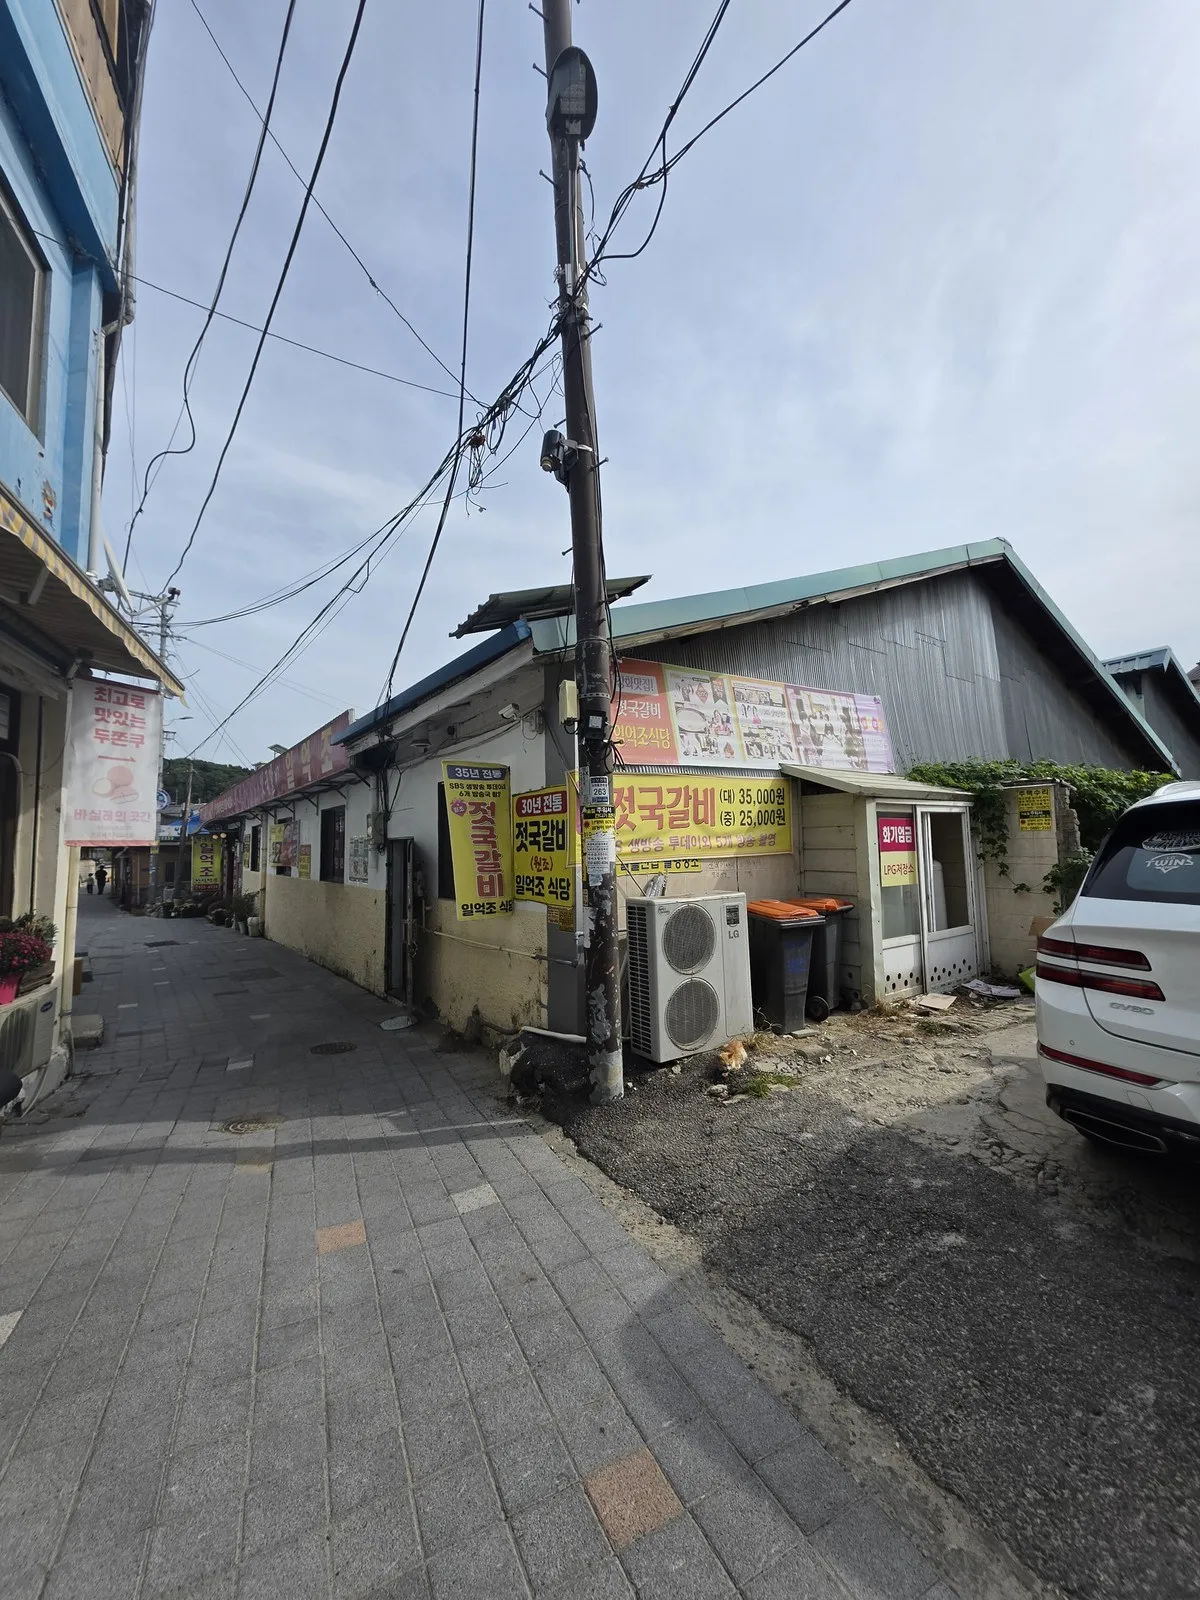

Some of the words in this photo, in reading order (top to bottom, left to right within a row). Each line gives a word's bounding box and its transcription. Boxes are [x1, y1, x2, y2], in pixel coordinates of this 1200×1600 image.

[95, 687, 146, 709] 최고로
[95, 707, 146, 729] 맛있는
[94, 728, 145, 748] 두쫀쿠
[455, 767, 480, 779] 35년
[593, 788, 607, 796] 263
[719, 788, 735, 804] (대)
[739, 787, 785, 806] 35,000원
[521, 798, 541, 814] 30년
[543, 792, 563, 811] 전통
[613, 784, 716, 832] 젓국갈비
[720, 810, 736, 827] (중)
[739, 808, 786, 828] 25,000원
[515, 819, 566, 852] 젓국갈비
[628, 837, 664, 854] 생방송
[716, 834, 733, 848] 5개
[736, 834, 755, 848] 방송
[882, 825, 912, 843] 화기엄금
[467, 800, 504, 897] 젓국갈비
[530, 855, 553, 872] (원조)
[883, 862, 915, 876] LPG저장소
[1145, 858, 1195, 868] TWINS
[515, 875, 545, 898] 일억조
[547, 877, 571, 901] 식당
[461, 902, 497, 917] 일억조
[728, 929, 740, 939] LG
